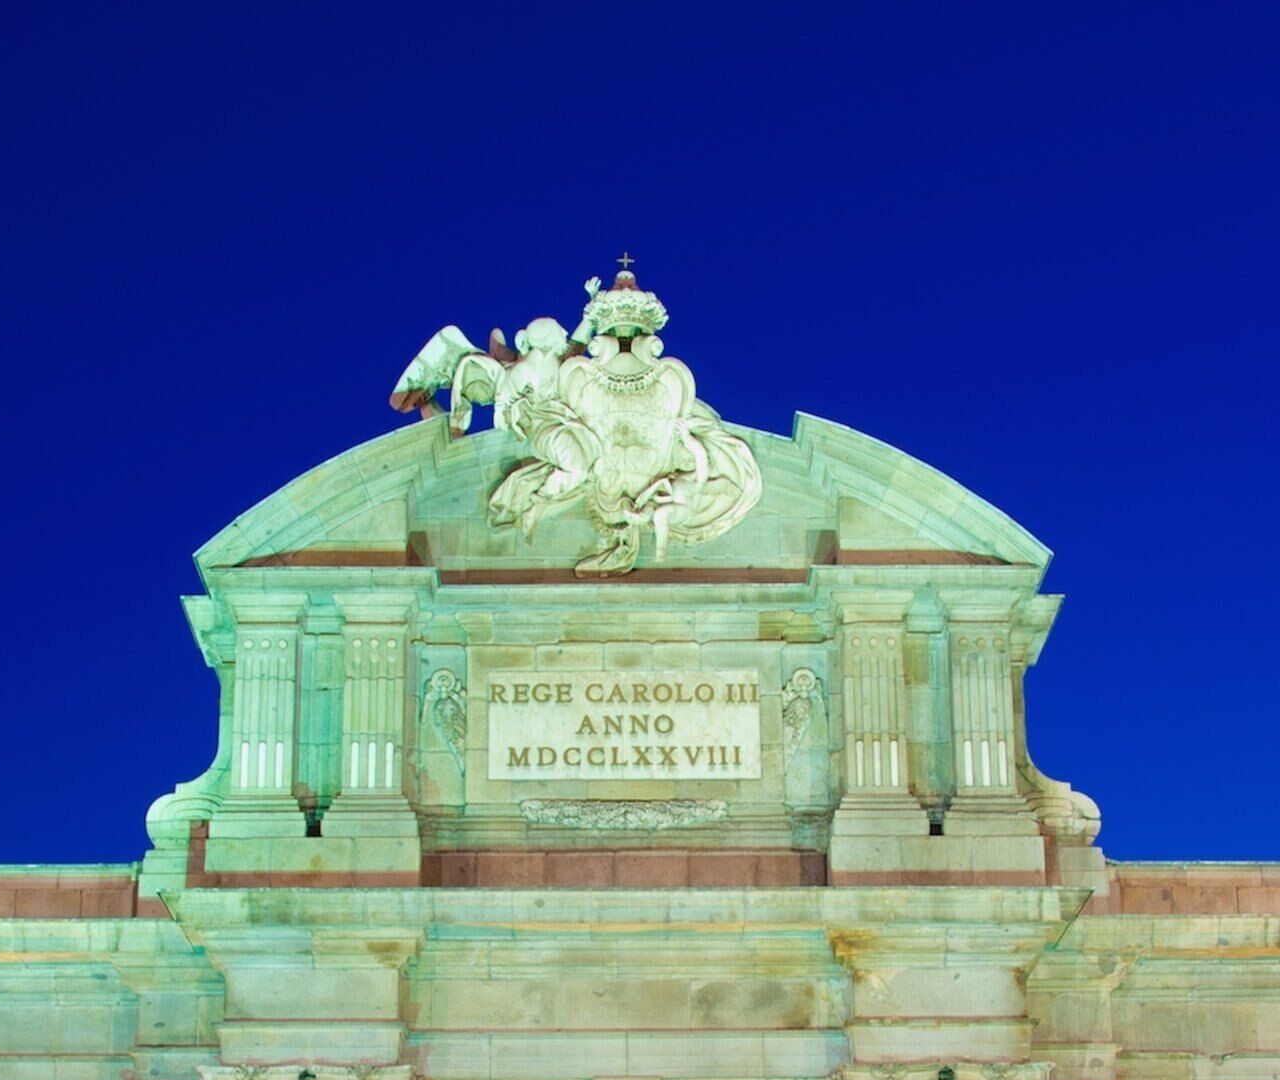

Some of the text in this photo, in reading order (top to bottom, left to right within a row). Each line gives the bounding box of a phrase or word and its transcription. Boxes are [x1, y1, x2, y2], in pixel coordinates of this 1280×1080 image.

[489, 683, 760, 704] REGE CAROLO III
[575, 714, 674, 735] ANNO
[506, 746, 742, 767] MDCCLXXVIII
